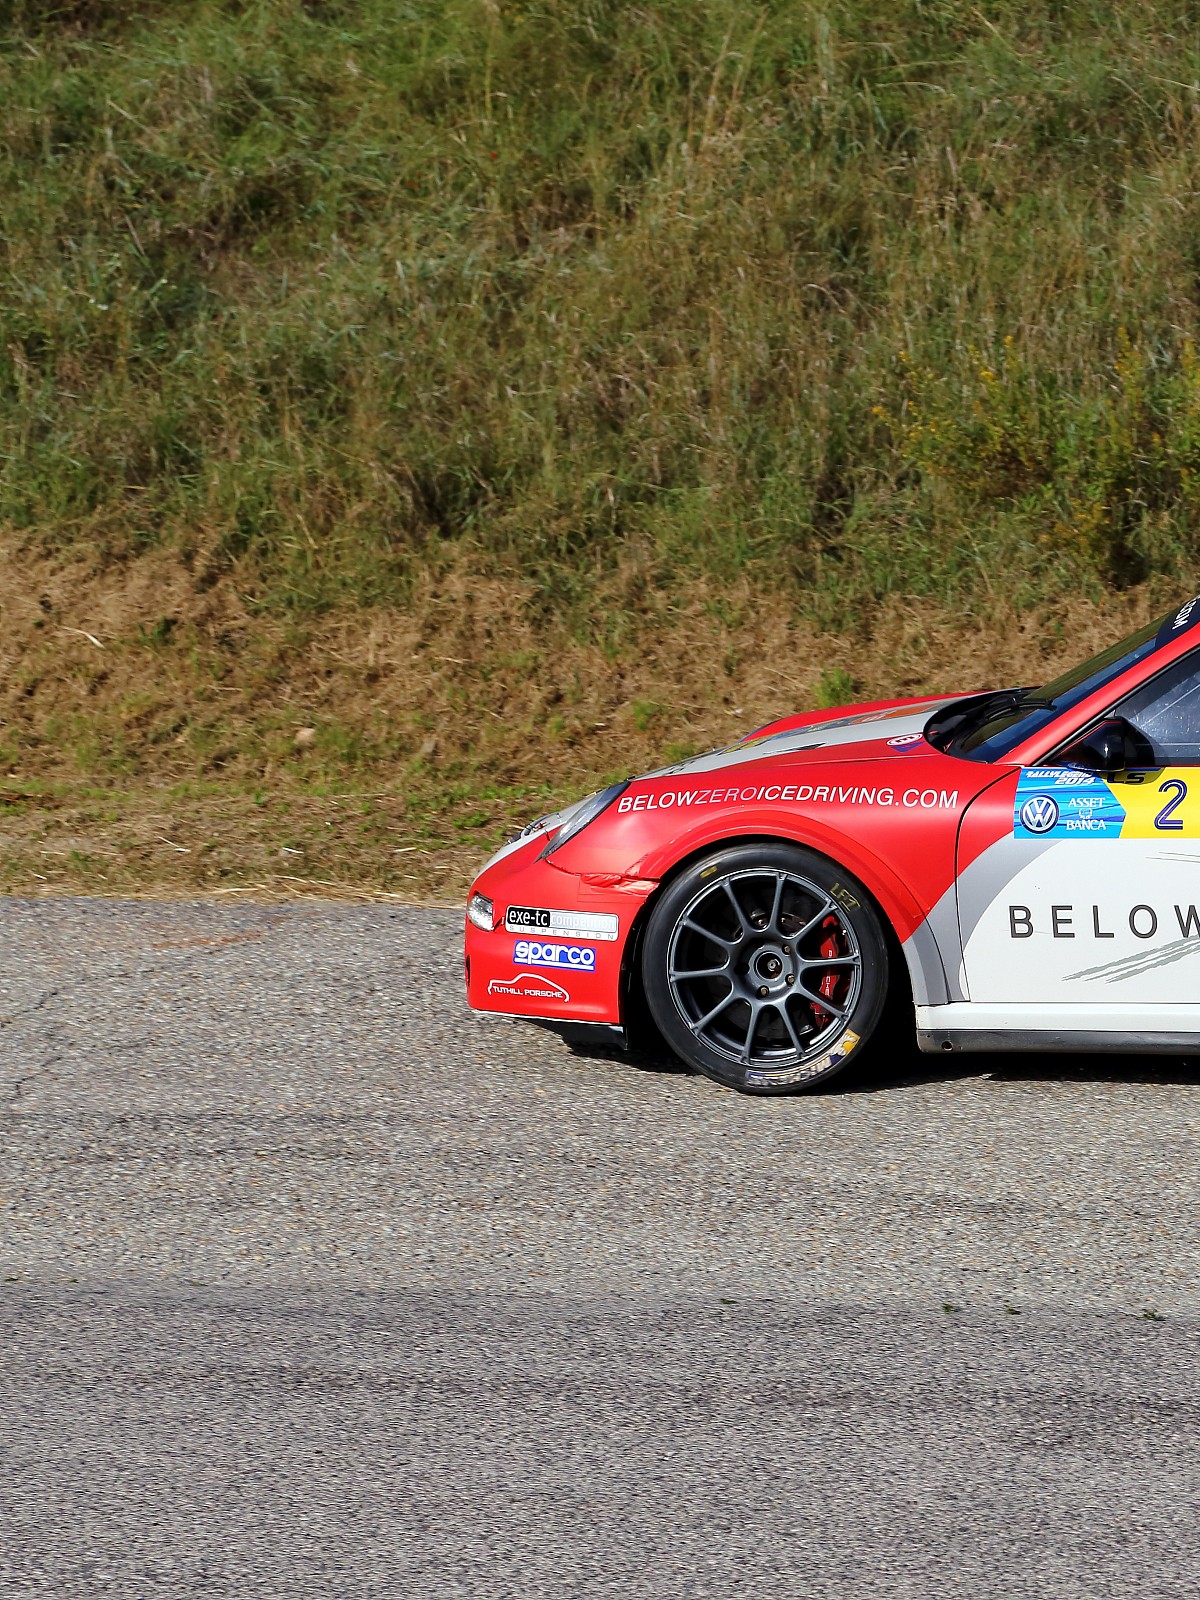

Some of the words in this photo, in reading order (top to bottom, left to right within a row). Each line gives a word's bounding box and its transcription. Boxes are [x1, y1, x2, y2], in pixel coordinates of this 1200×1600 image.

[1054, 777, 1096, 785] 2014
[1067, 797, 1106, 808] ASSET
[1154, 778, 1188, 831] 2
[1066, 819, 1107, 831] BANCA
[509, 910, 548, 926] exe-tc
[509, 925, 614, 940] SUSPENSION
[514, 941, 595, 965] sparco
[492, 985, 523, 996] TUTHILL
[524, 988, 563, 998] PORSCHE
